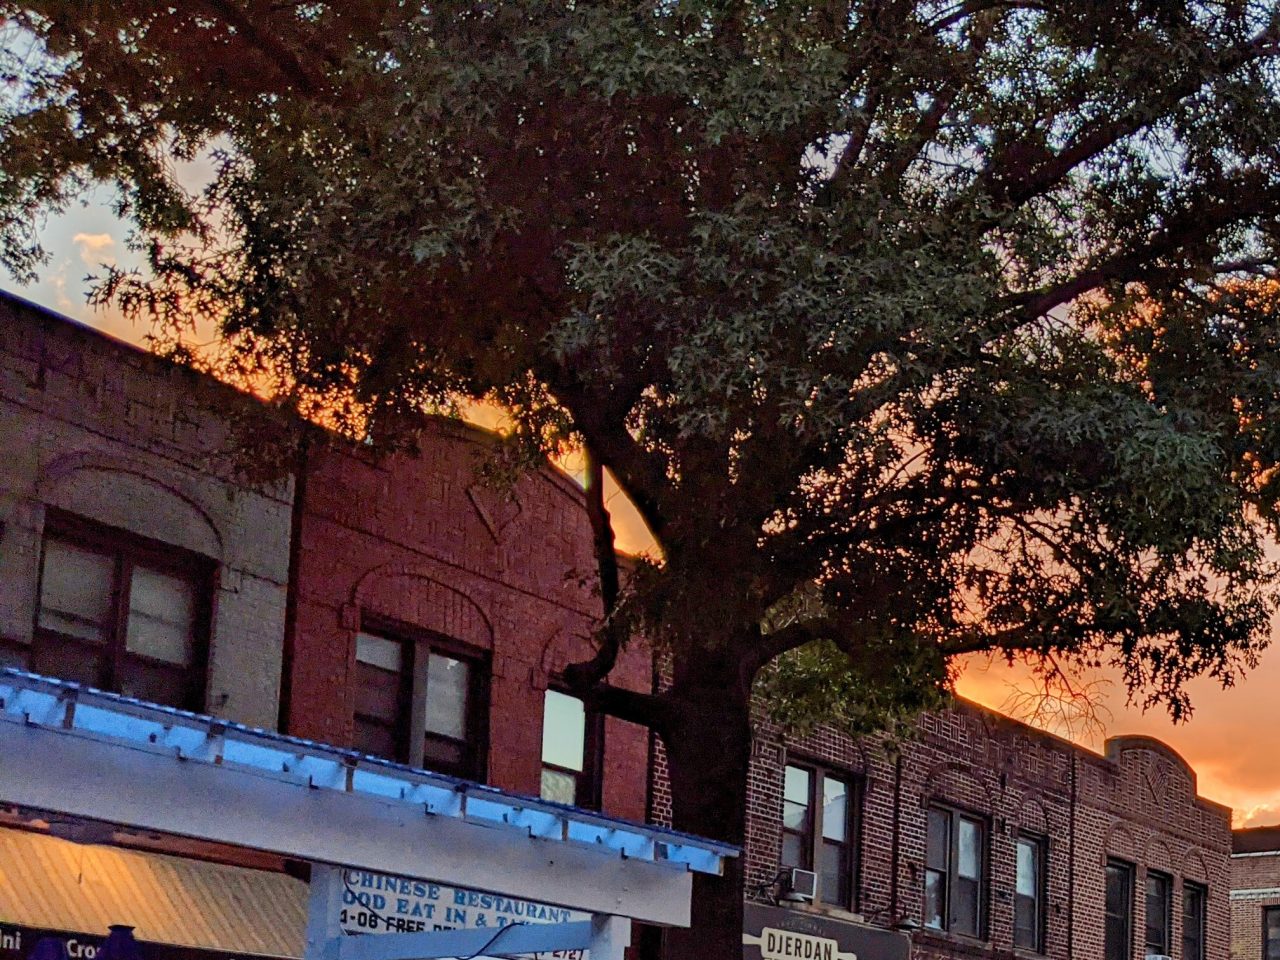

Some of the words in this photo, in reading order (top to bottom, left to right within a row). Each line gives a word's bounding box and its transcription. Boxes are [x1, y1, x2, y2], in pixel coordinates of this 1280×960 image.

[342, 889, 386, 910] OOD
[396, 898, 436, 918] EAT
[446, 908, 466, 924] IN
[475, 912, 487, 927] &
[347, 872, 440, 899] CHINESE
[453, 889, 571, 922] RESTAURANT
[66, 939, 101, 959] Cro
